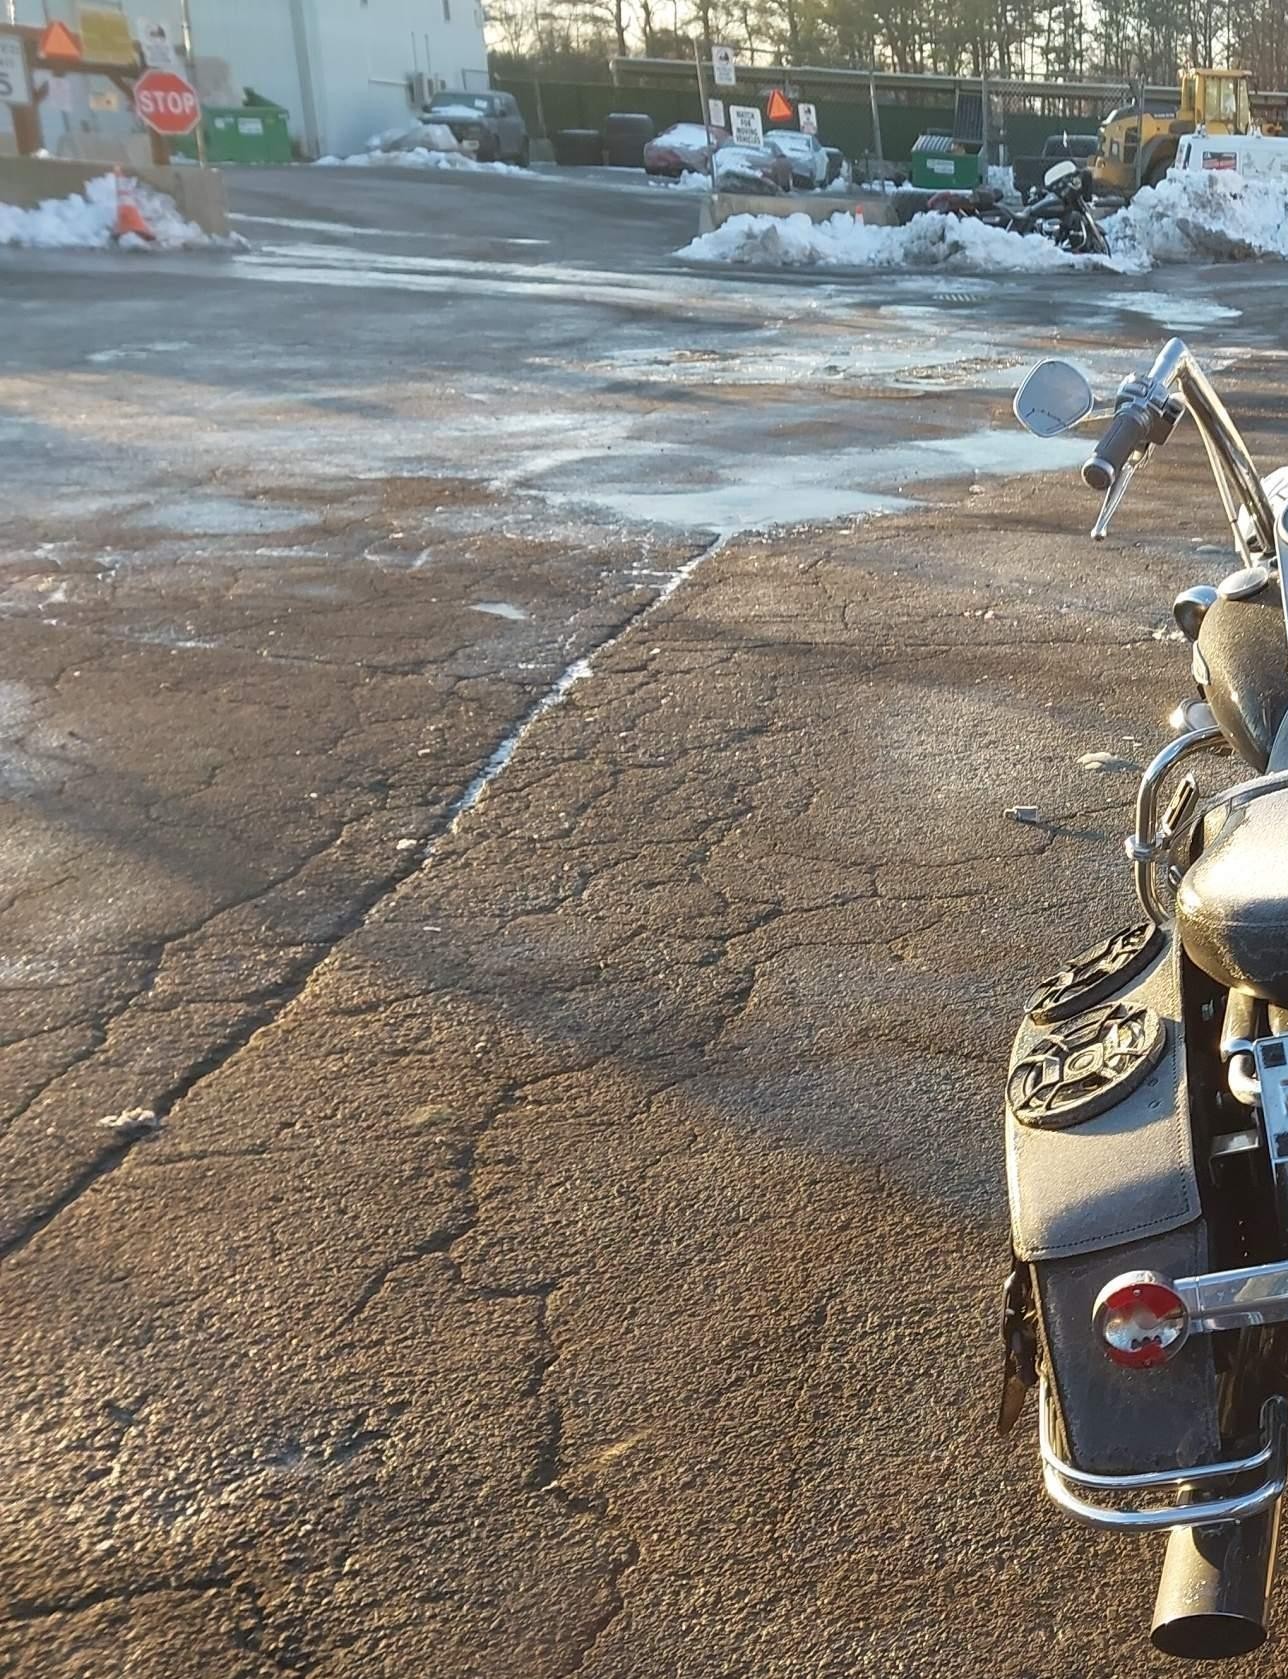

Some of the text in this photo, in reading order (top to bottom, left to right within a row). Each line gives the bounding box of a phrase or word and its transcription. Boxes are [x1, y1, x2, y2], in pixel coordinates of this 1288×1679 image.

[140, 90, 195, 115] STOP
[736, 111, 755, 119] WATCH
[740, 118, 751, 127] FOR
[736, 127, 758, 136] MOVING
[736, 135, 761, 144] VEHICLES
